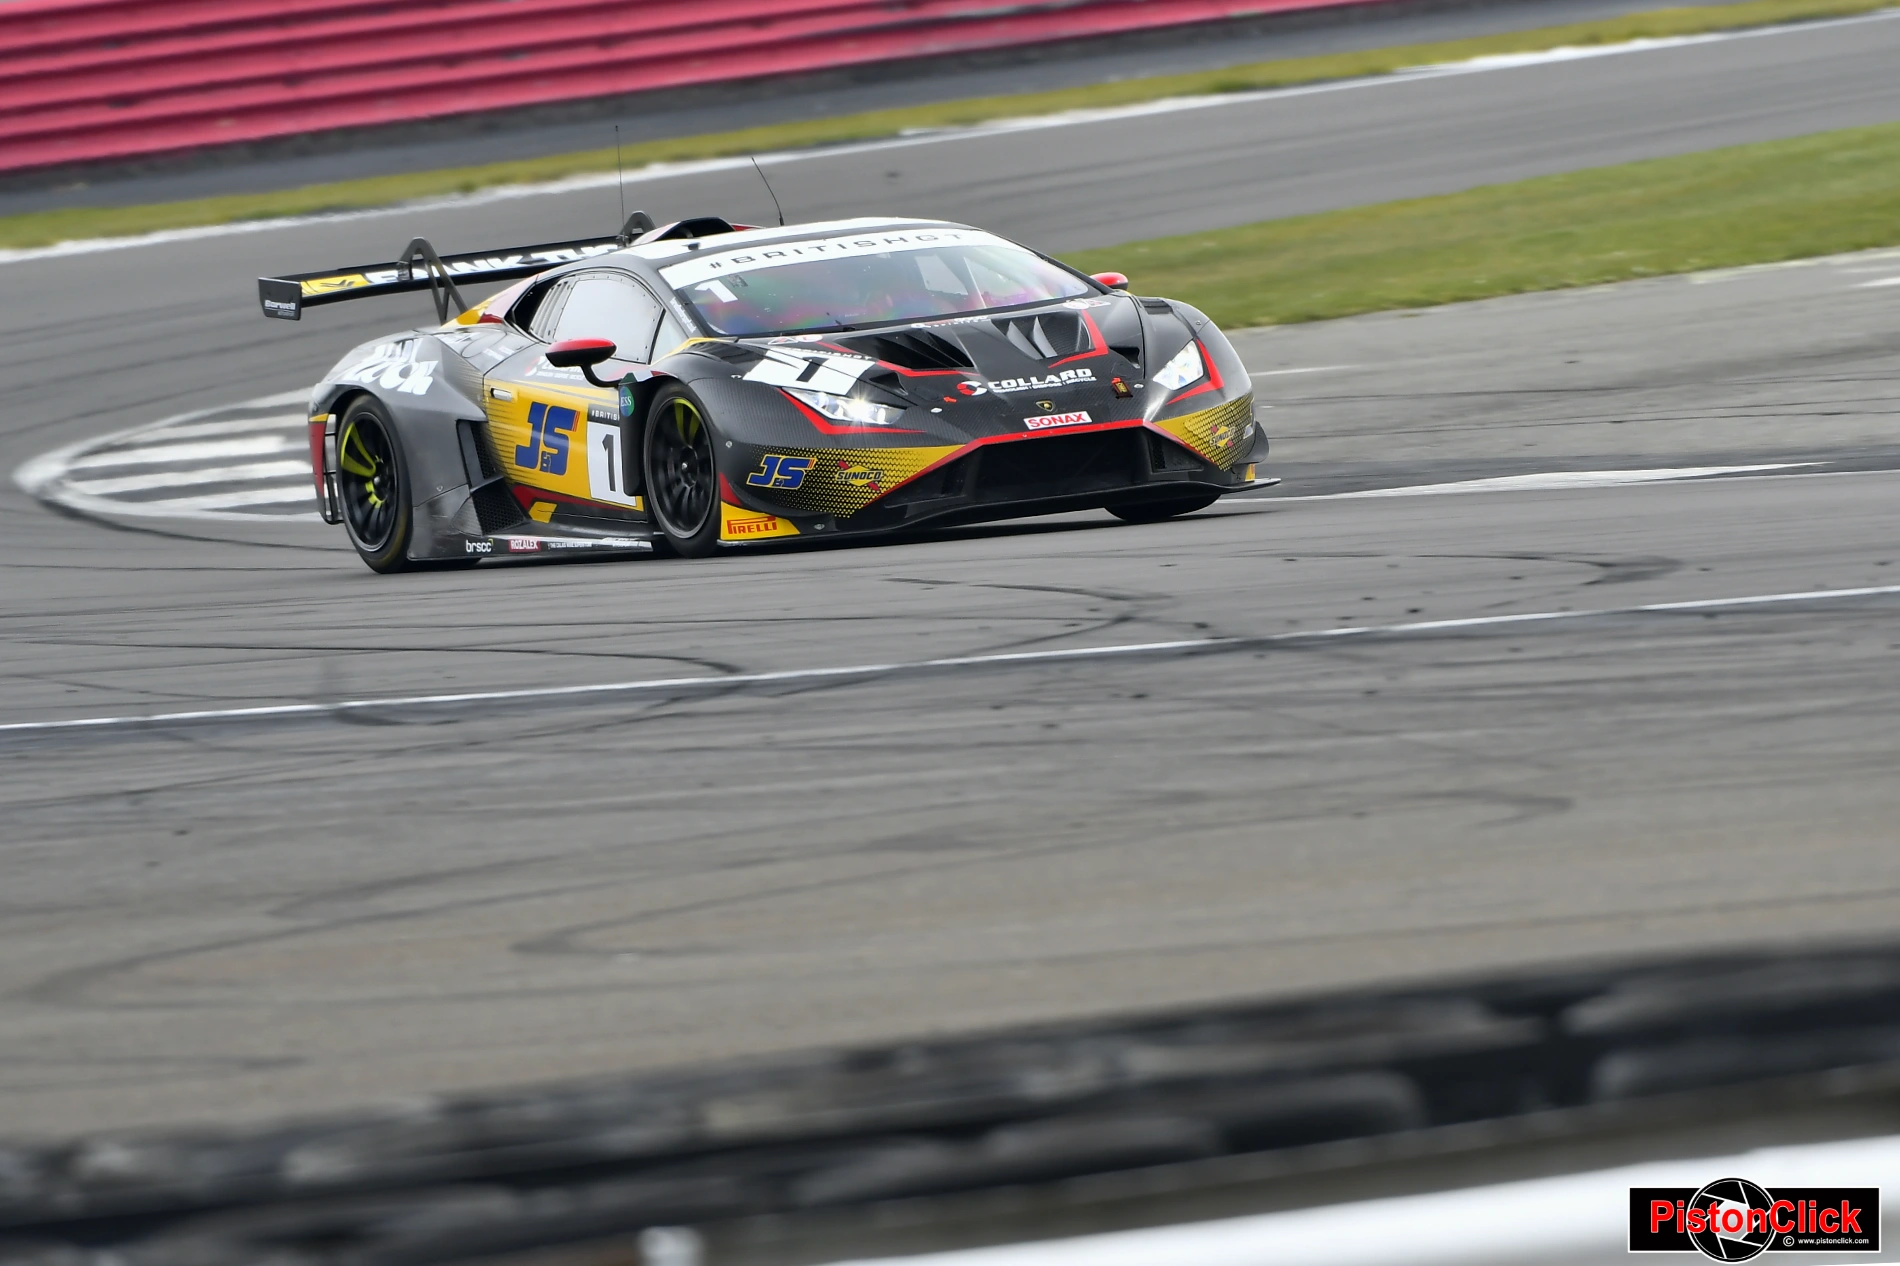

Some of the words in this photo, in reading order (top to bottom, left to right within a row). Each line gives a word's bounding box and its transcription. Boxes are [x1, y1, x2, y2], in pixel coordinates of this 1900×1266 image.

[709, 233, 963, 269] #BRITISHGT
[694, 279, 738, 303] 1
[796, 356, 830, 383] 1
[988, 368, 1093, 389] COLLARD
[620, 396, 632, 407] ESS
[591, 409, 620, 421] #BRITIS
[1027, 413, 1085, 428] SONAX
[514, 400, 581, 476] JS
[601, 433, 617, 493] 1
[746, 454, 817, 490] JS
[836, 470, 883, 482] SUNOCO
[726, 516, 778, 535] PIRELLI
[465, 539, 492, 553] brscc
[510, 539, 539, 550] ROZALEX
